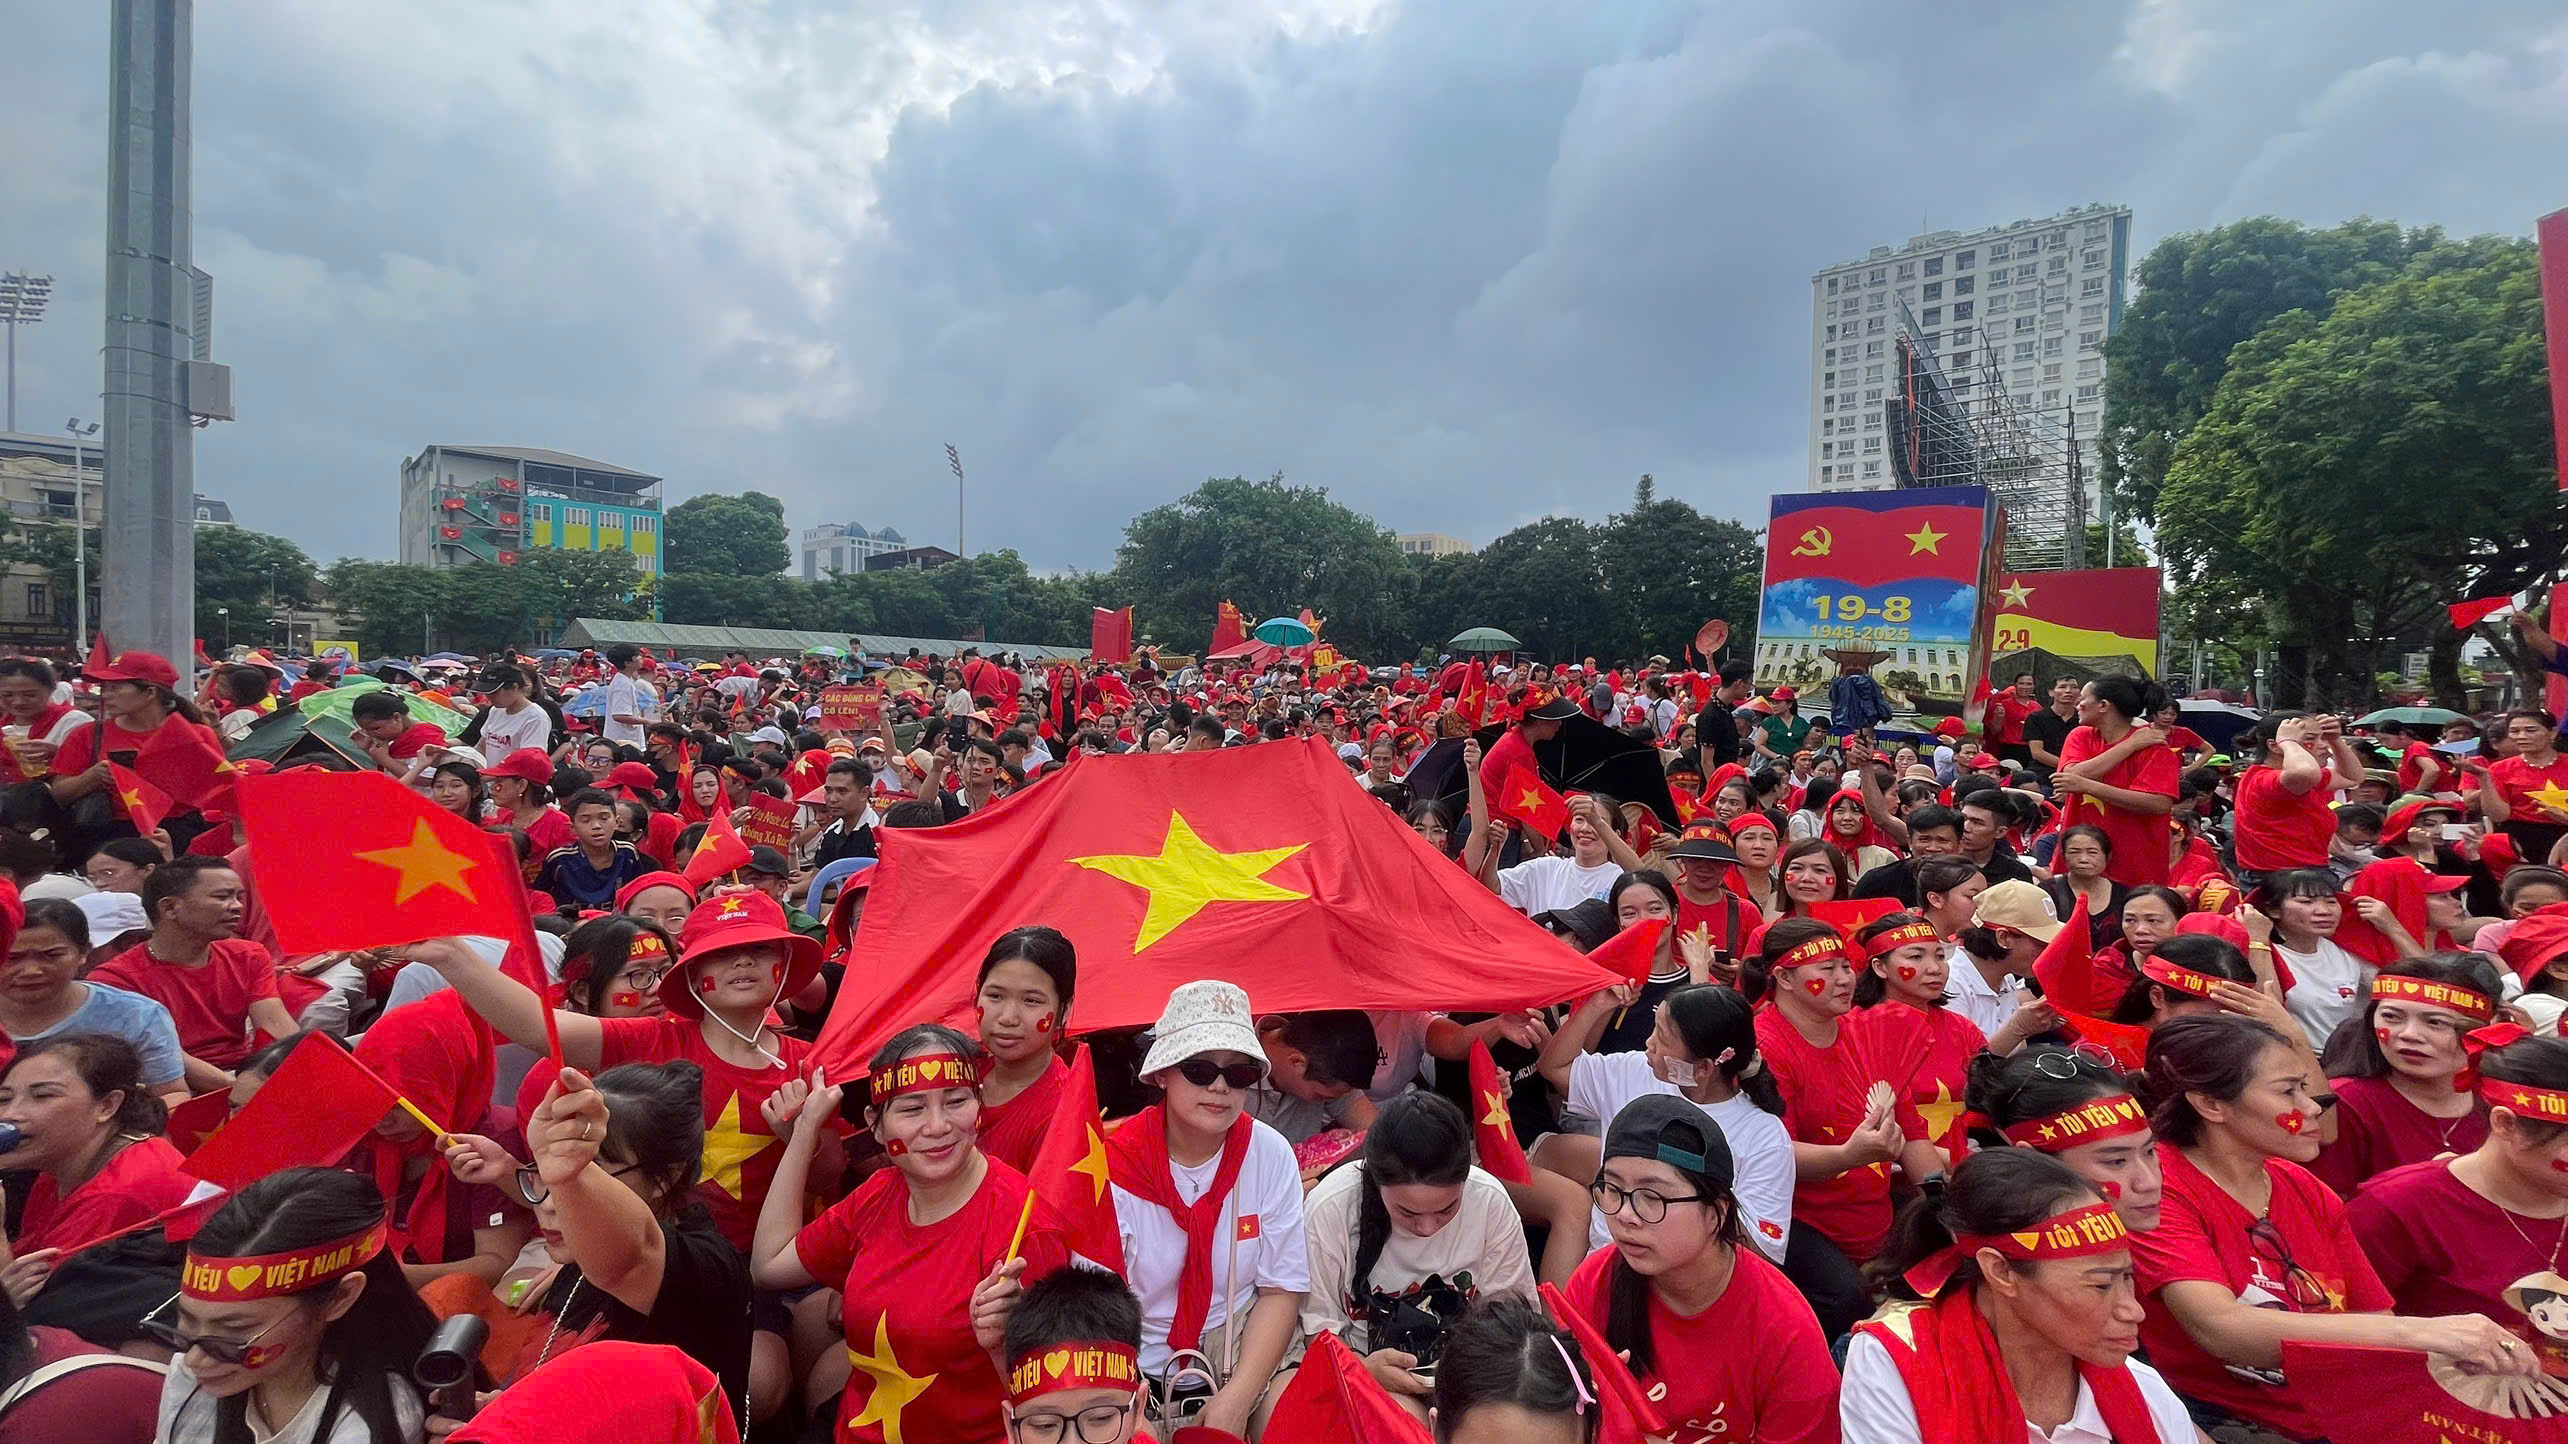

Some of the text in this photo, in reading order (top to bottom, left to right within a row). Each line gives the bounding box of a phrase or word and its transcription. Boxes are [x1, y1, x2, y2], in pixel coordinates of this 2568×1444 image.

[1813, 595, 1912, 623] 19-8
[1811, 624, 1910, 642] 1945-2025
[1999, 629, 2030, 650] 2-9
[1314, 649, 1334, 667] 80
[1903, 923, 1933, 939] TÔI YÊU
[1803, 937, 1837, 958] TÔI YÊU
[2184, 974, 2203, 991] TÔI
[2382, 978, 2400, 993] YÊU
[2424, 984, 2449, 1002] VIỆT
[897, 1063, 917, 1087] YÊU
[2537, 1093, 2567, 1116] TÔI
[2055, 1111, 2088, 1137] TÔI
[2080, 1104, 2119, 1129] YÊU
[2076, 1212, 2117, 1244] YÊU
[193, 1263, 223, 1292] YÊU
[266, 1257, 310, 1289] VIỆT
[311, 1245, 354, 1277] NAM
[1023, 1357, 1041, 1391] YÊU
[1073, 1346, 1104, 1382] VIỆT
[1106, 1352, 1128, 1381] NAM
